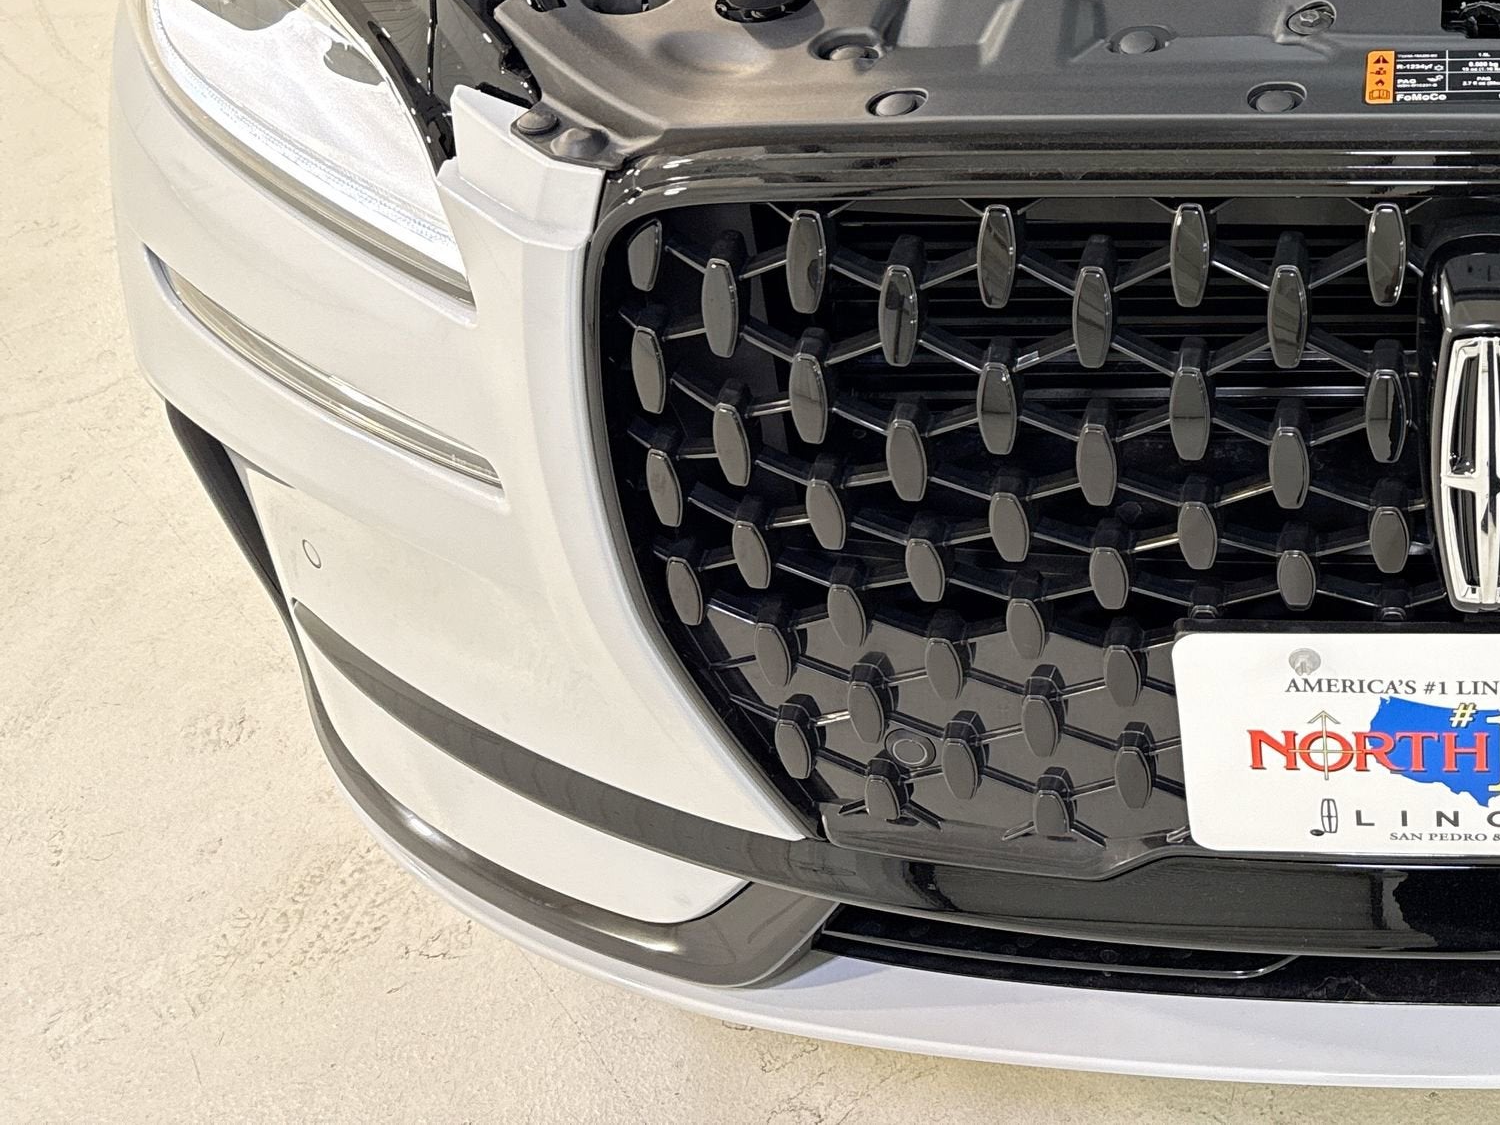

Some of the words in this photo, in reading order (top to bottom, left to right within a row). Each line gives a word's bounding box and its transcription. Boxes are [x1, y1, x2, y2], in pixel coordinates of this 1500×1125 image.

[1396, 93, 1447, 101] FoMoCo
[1284, 678, 1417, 695] AMERICA'S
[1423, 680, 1448, 695] #1
[1247, 730, 1491, 772] NORTH
[1389, 832, 1426, 842] SAN
[1428, 832, 1488, 843] PEDRO
